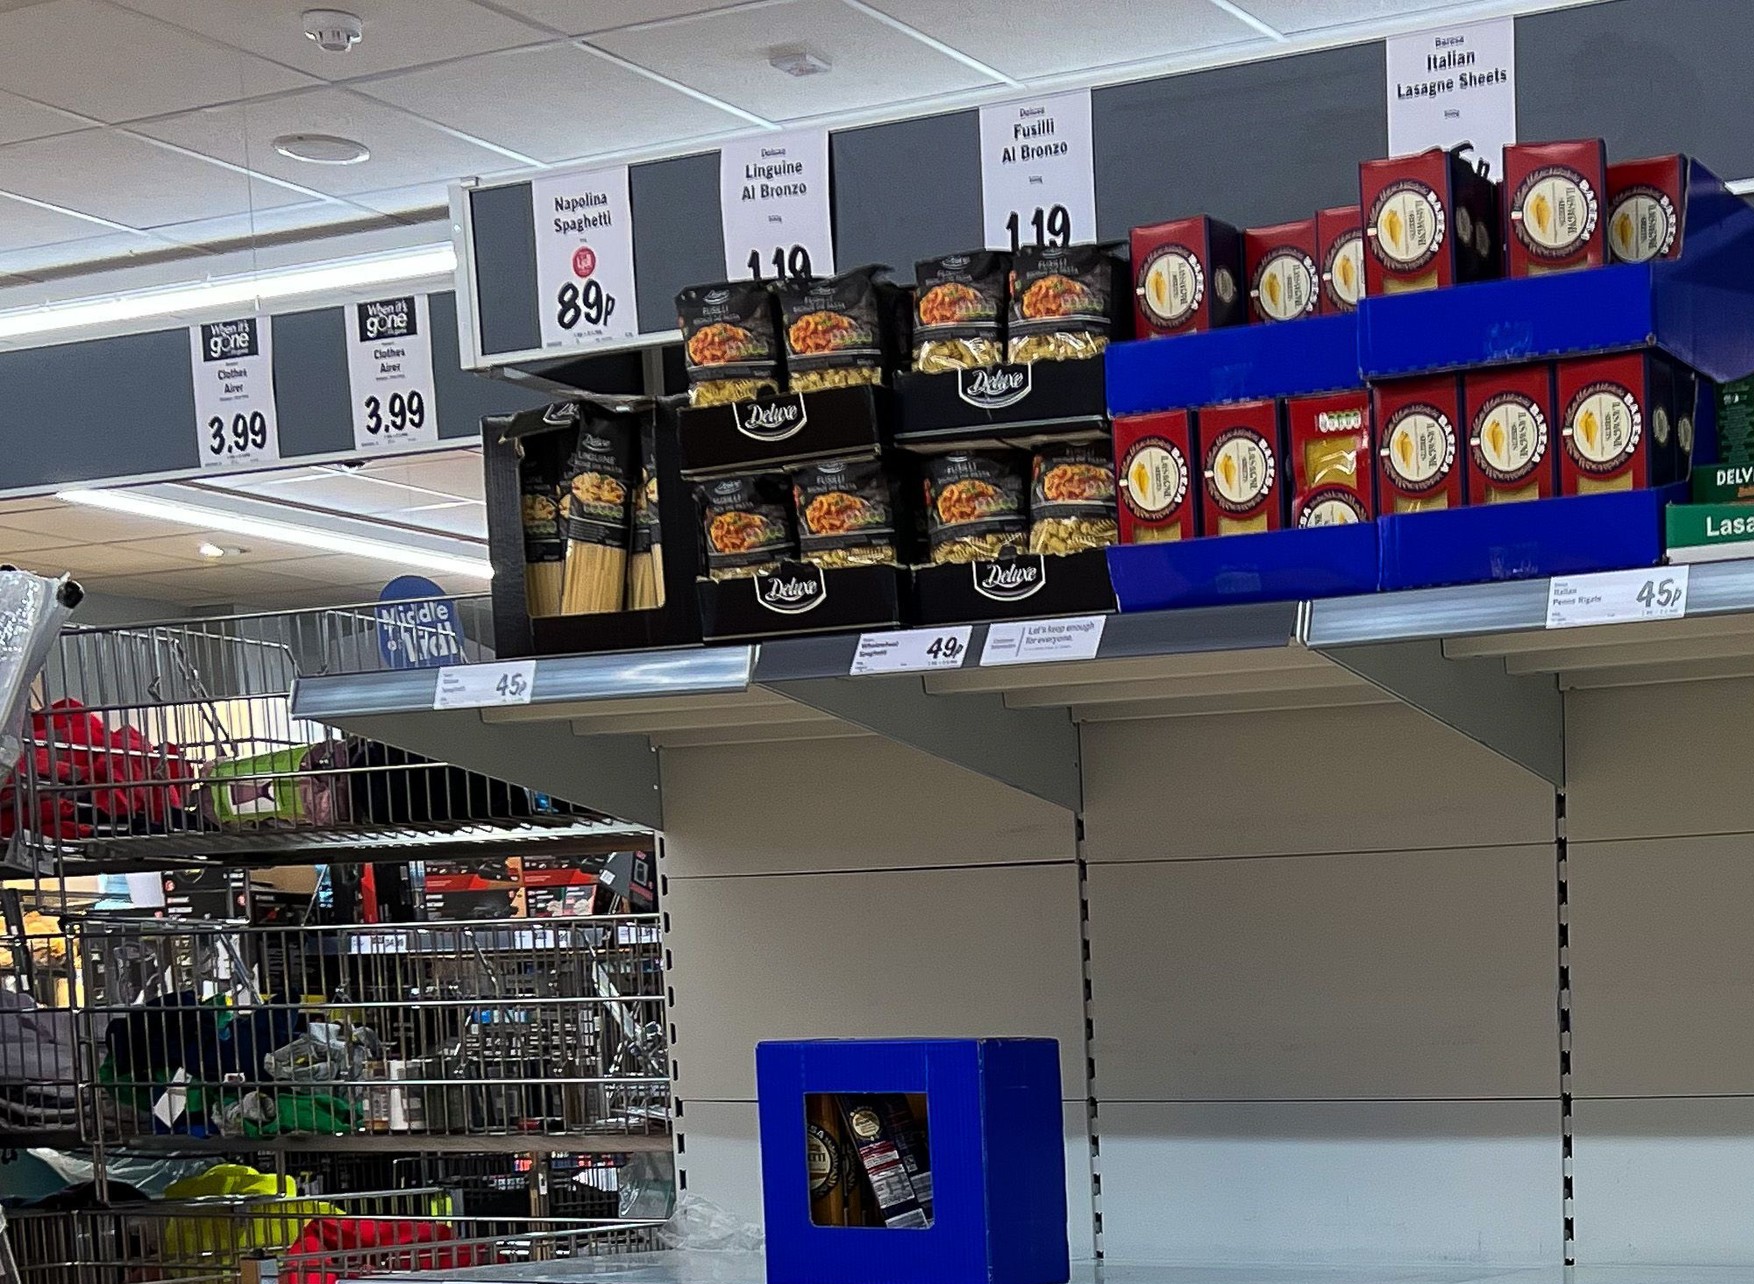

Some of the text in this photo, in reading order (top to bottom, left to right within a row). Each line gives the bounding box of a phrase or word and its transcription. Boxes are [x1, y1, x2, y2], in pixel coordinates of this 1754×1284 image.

[1427, 50, 1475, 71] Italian
[1397, 67, 1507, 99] Lasagne Sheets
[1014, 117, 1055, 139] Fusilli
[1002, 140, 1068, 164] Al Bronzo
[745, 161, 803, 180] Linguine
[554, 192, 608, 212] Napolina
[742, 180, 807, 200] Al Bronzo
[553, 210, 612, 234] Spaghetti
[557, 278, 616, 330] 89p
[366, 312, 408, 337] gone
[210, 333, 250, 357] gone
[373, 349, 406, 360] Clothes
[217, 368, 248, 380] Clothes
[380, 362, 401, 374] Airer
[223, 382, 244, 394] Airer
[966, 370, 1024, 396] Deluxe
[364, 390, 425, 435] 3.99
[745, 402, 798, 429] Deluxe
[1623, 392, 1642, 453] BARESA
[208, 410, 267, 455] 3.99
[1529, 402, 1548, 463] BARESA
[1170, 447, 1188, 503] BARESA
[1258, 438, 1275, 495] BARESA
[981, 564, 1037, 588] Deluxe
[765, 577, 818, 601] Deluxe
[1636, 578, 1683, 607] 45p
[381, 601, 449, 630] Middle
[926, 636, 963, 659] 49p
